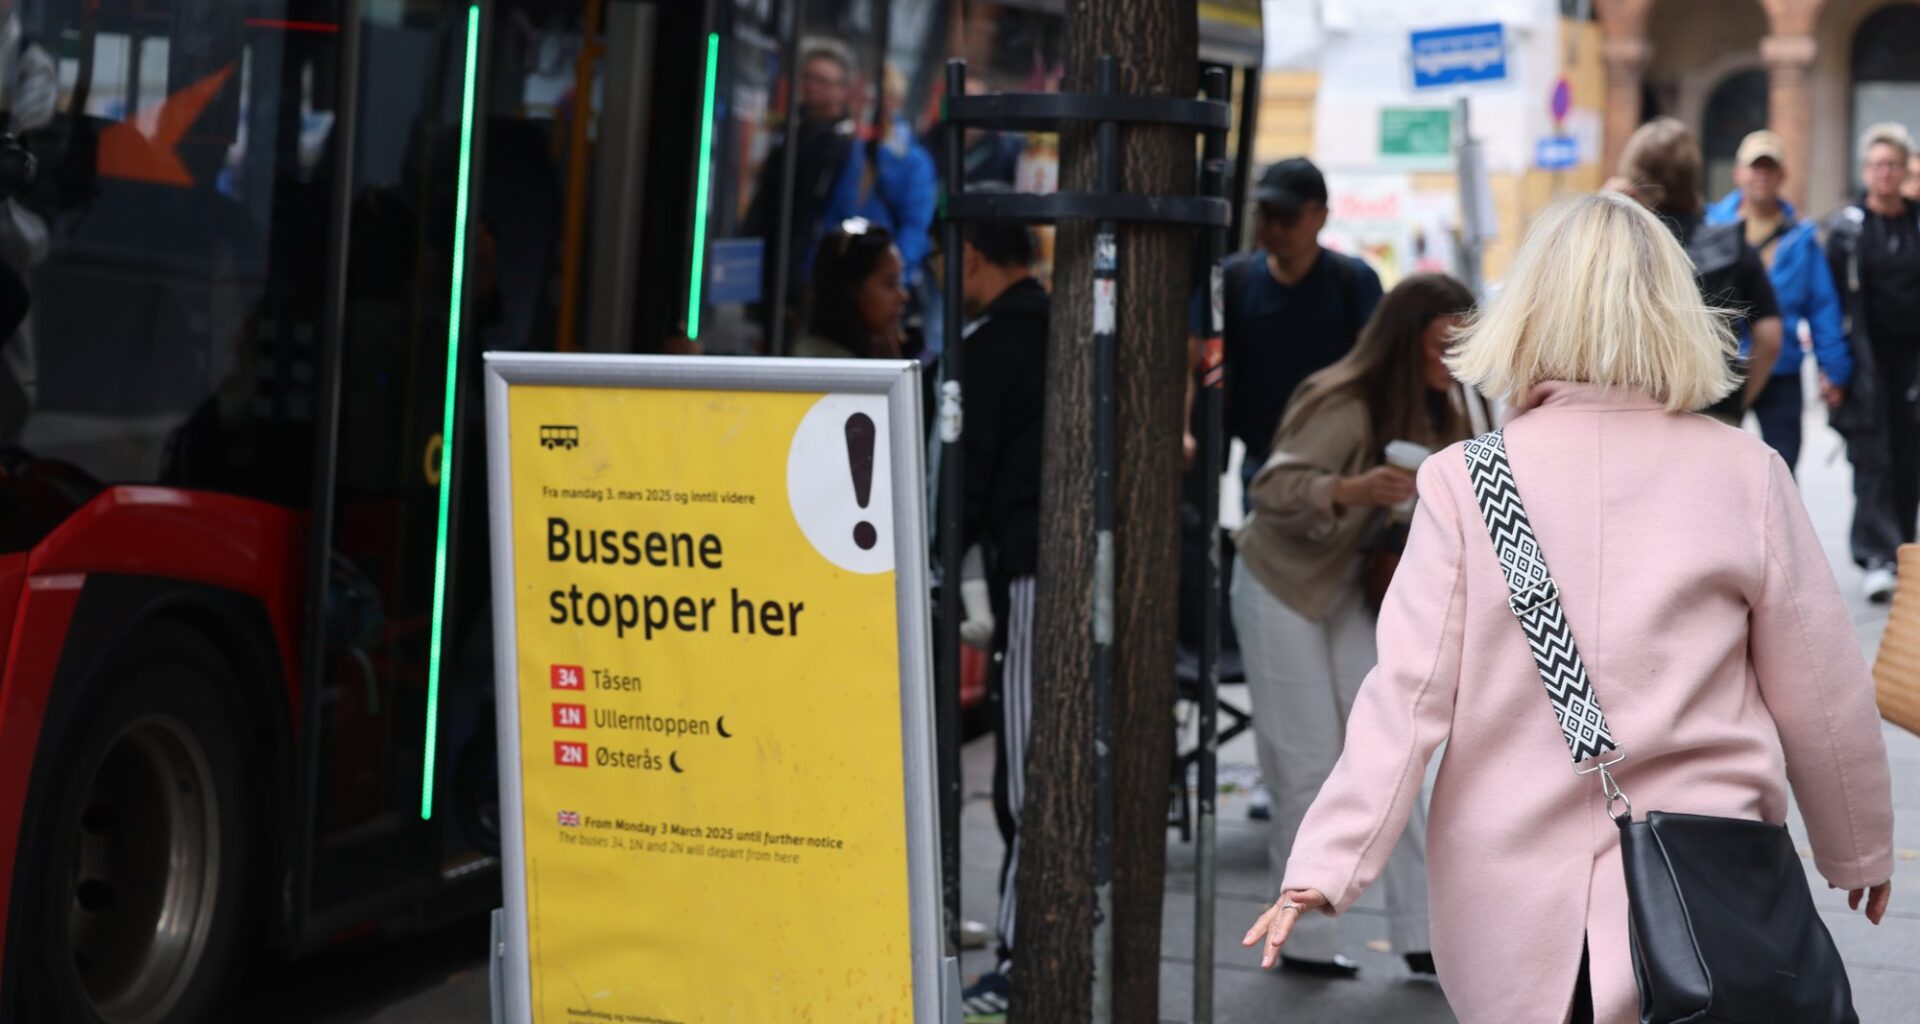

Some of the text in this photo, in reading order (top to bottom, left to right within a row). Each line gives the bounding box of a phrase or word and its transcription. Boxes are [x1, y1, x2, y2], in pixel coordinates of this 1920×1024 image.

[542, 486, 755, 505] Fra mandag 3. mars 2025 og inntil videre
[547, 517, 723, 569] Bussene
[549, 584, 804, 640] stopper her
[559, 668, 641, 691] 34 Tåsen
[559, 707, 710, 737] 1N Ullerntoppen
[560, 745, 663, 770] 2N Østerås
[559, 831, 576, 845] The
[579, 834, 608, 848] buses
[629, 838, 643, 850] 1N
[646, 840, 667, 852] and
[669, 841, 684, 854] 2N
[687, 844, 704, 856] will
[707, 846, 744, 860] depart
[746, 848, 772, 862] from
[773, 851, 800, 864] here
[585, 816, 843, 849] From Monday 3 March 2025 until further notice
